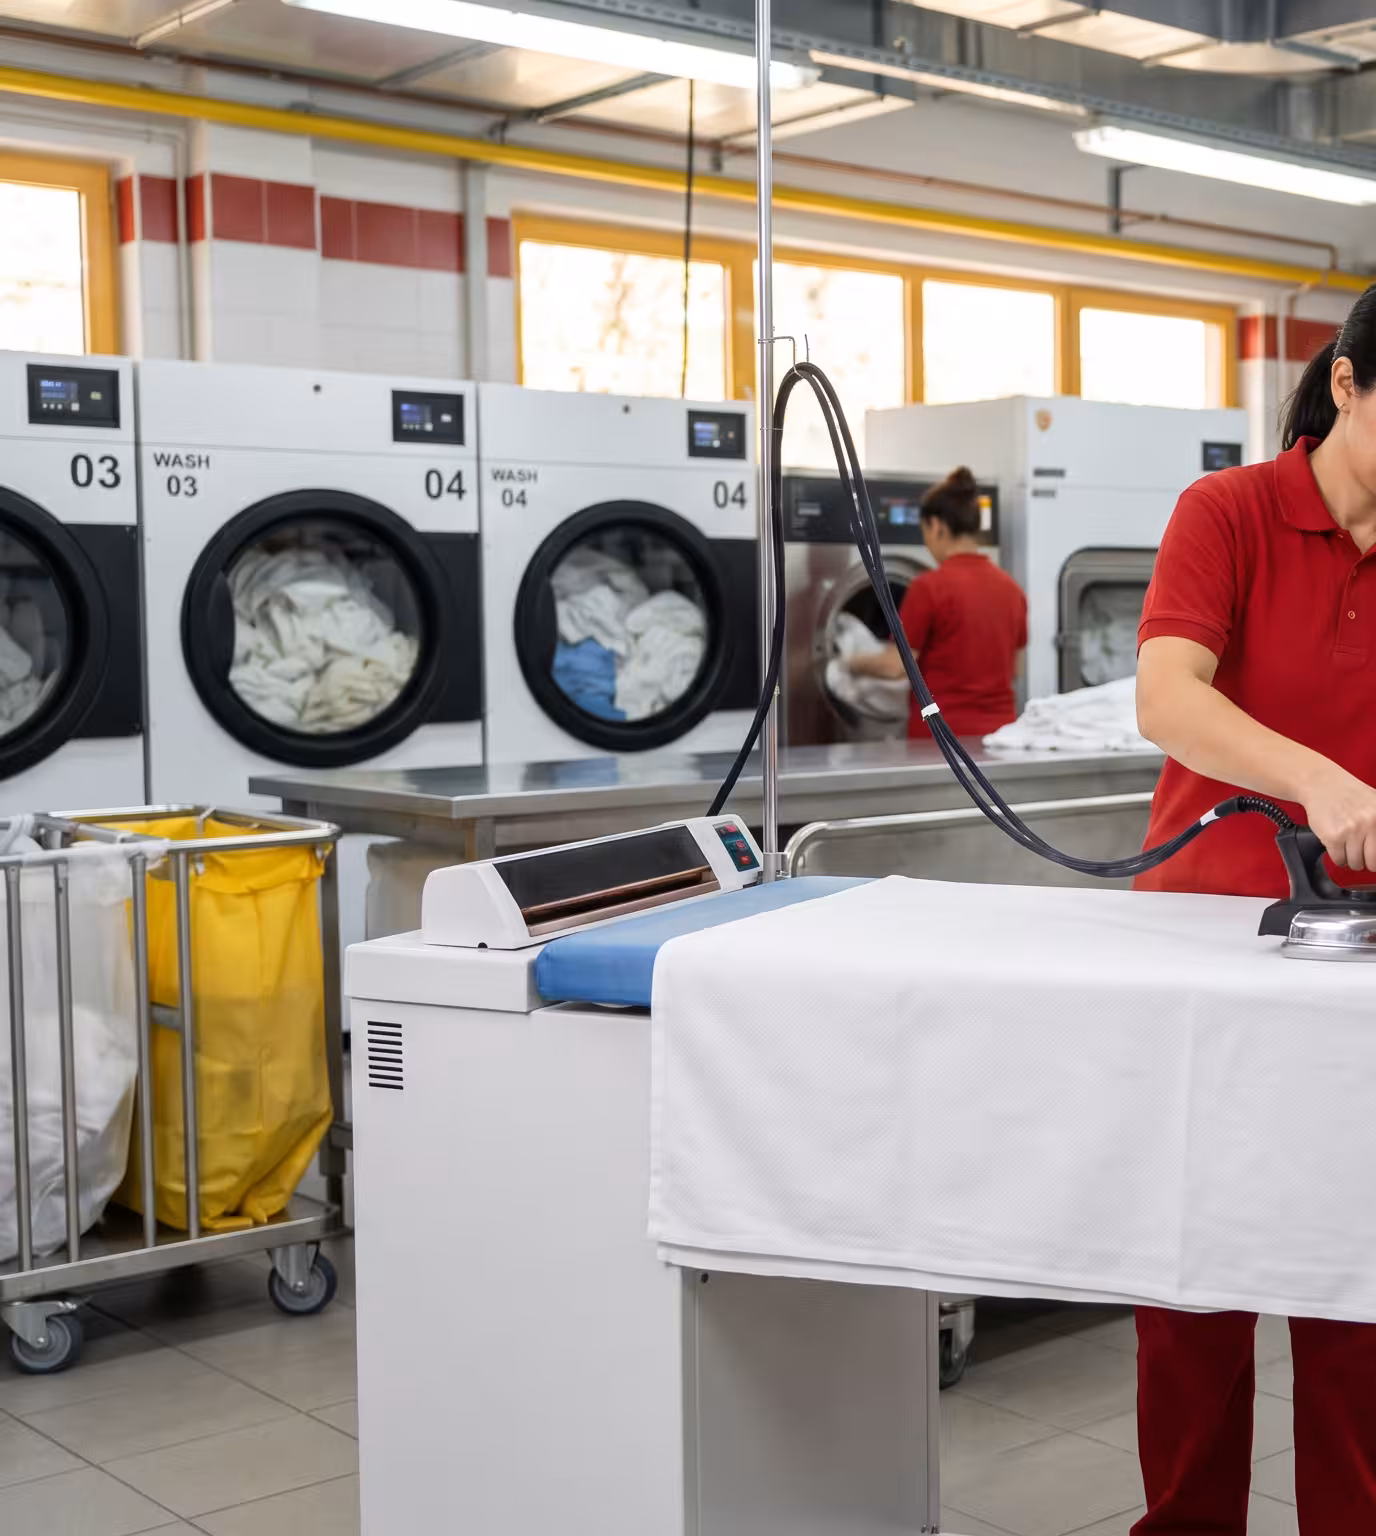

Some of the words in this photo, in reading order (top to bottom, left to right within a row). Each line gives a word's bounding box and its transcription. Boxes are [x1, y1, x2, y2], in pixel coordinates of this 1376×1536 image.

[70, 453, 122, 489] 03
[153, 452, 210, 468] WASH
[166, 474, 198, 497] 03
[425, 468, 467, 500] 04
[492, 469, 538, 482] WASH
[501, 488, 528, 508] 04
[713, 480, 747, 509] 04
